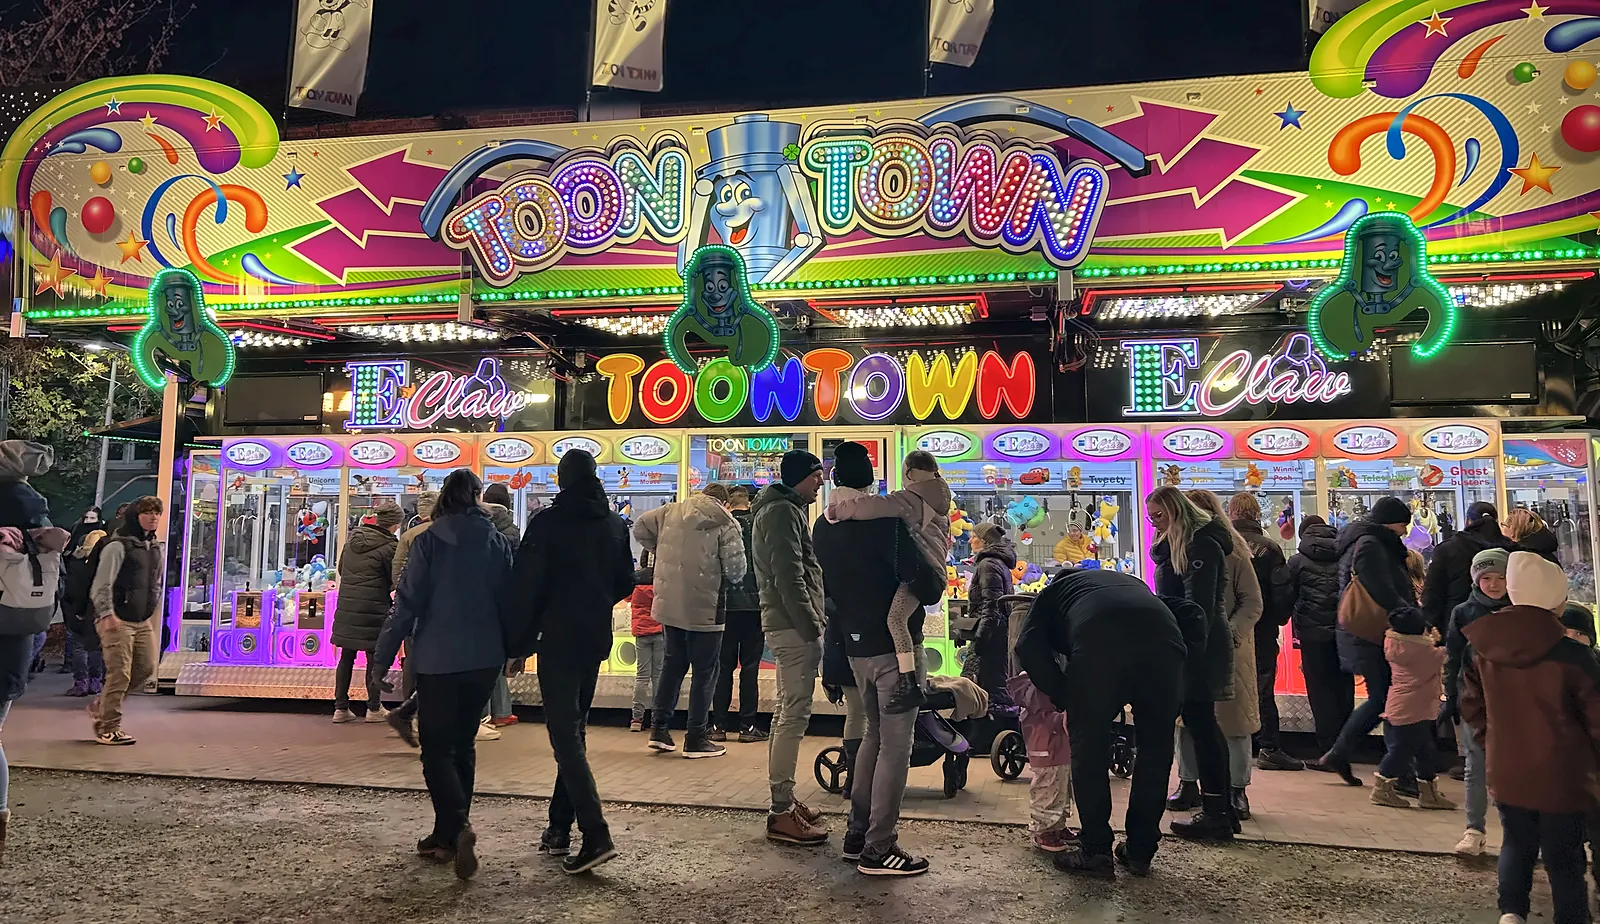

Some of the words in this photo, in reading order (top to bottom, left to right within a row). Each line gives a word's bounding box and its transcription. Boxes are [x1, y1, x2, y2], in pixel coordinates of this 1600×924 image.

[447, 148, 688, 278] TOON
[805, 133, 1104, 262] TOWN
[344, 360, 411, 429] E
[407, 370, 528, 430] Claw
[1121, 337, 1201, 417] E
[1199, 348, 1352, 418] Claw
[1089, 475, 1126, 485] Tweety
[1450, 466, 1488, 476] Ghost
[1451, 478, 1490, 486] busters
